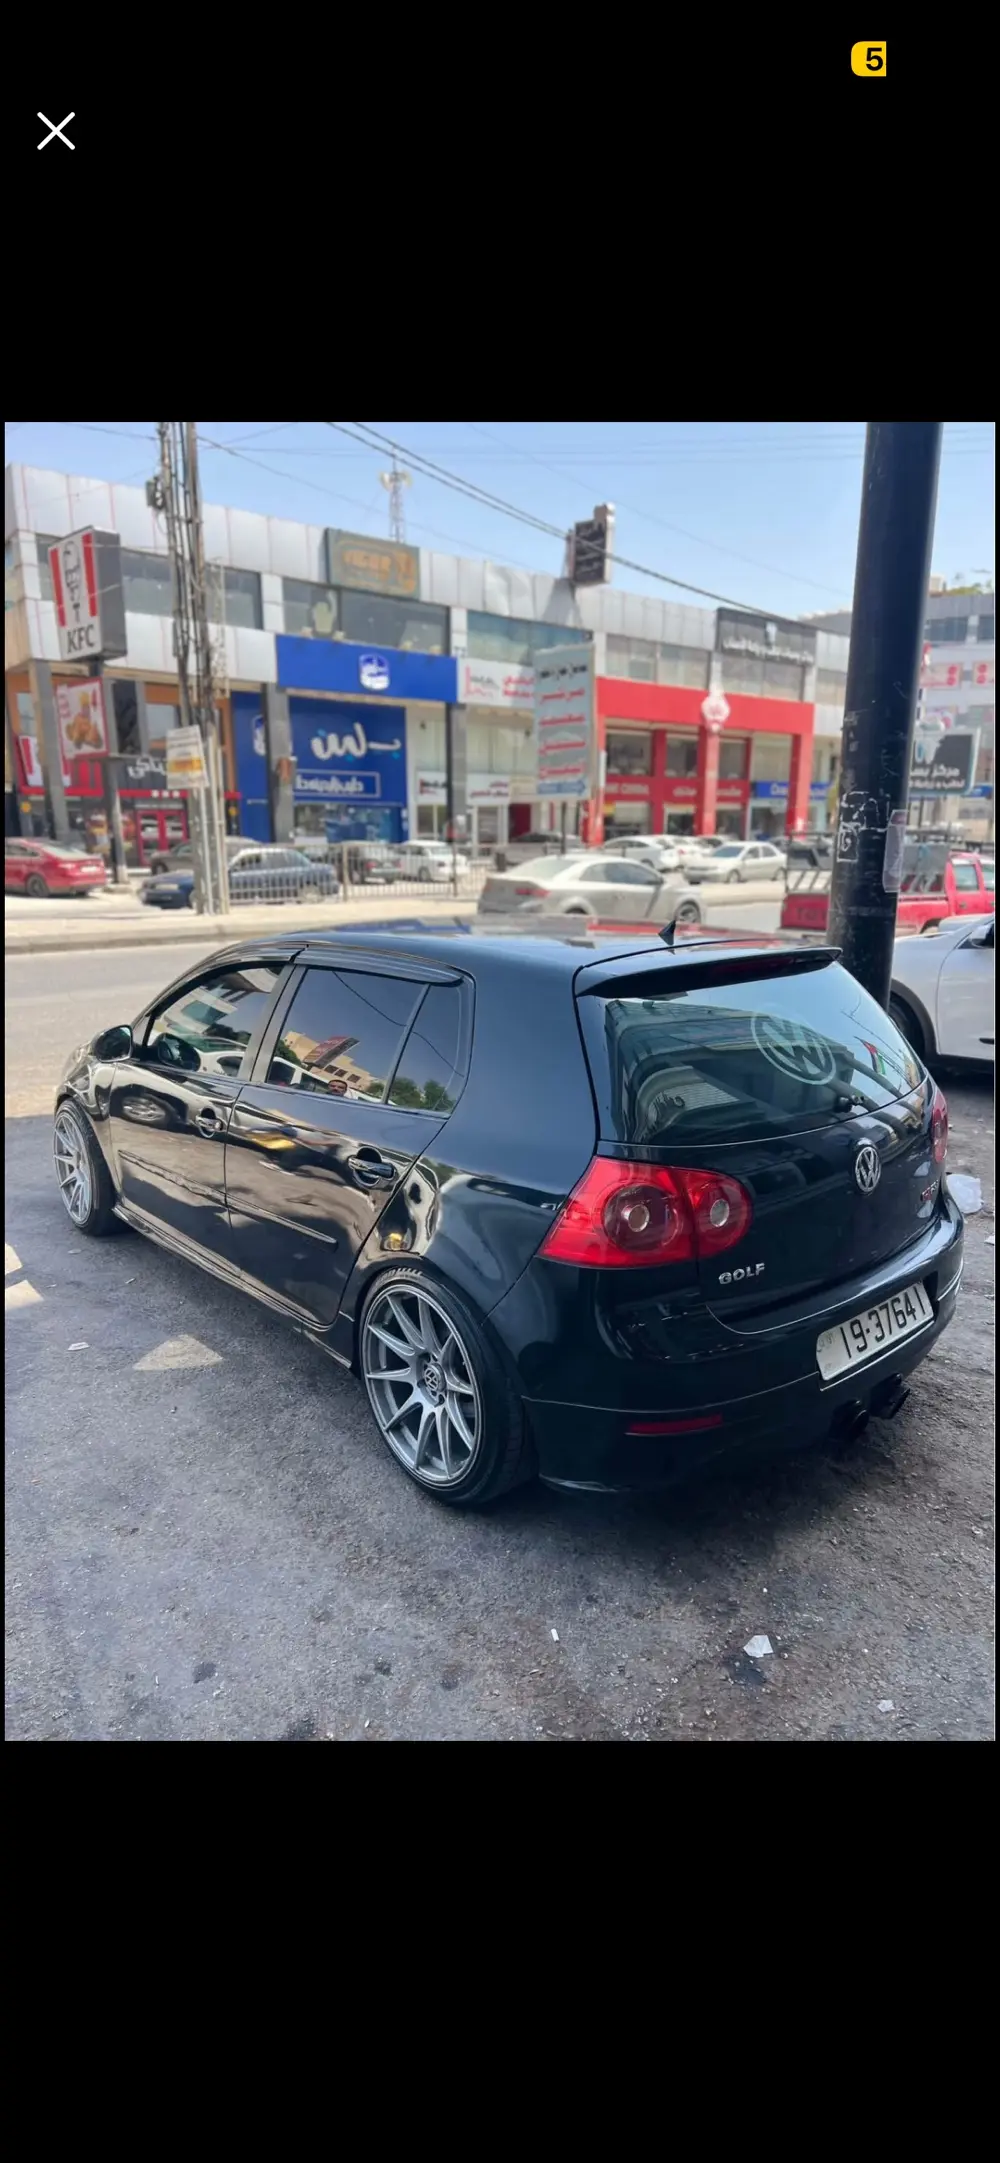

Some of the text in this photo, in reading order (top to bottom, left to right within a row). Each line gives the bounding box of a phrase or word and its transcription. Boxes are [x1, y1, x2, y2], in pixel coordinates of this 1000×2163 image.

[66, 623, 96, 654] KFC
[718, 1262, 766, 1285] GOLF
[839, 1285, 927, 1360] 19-37641
